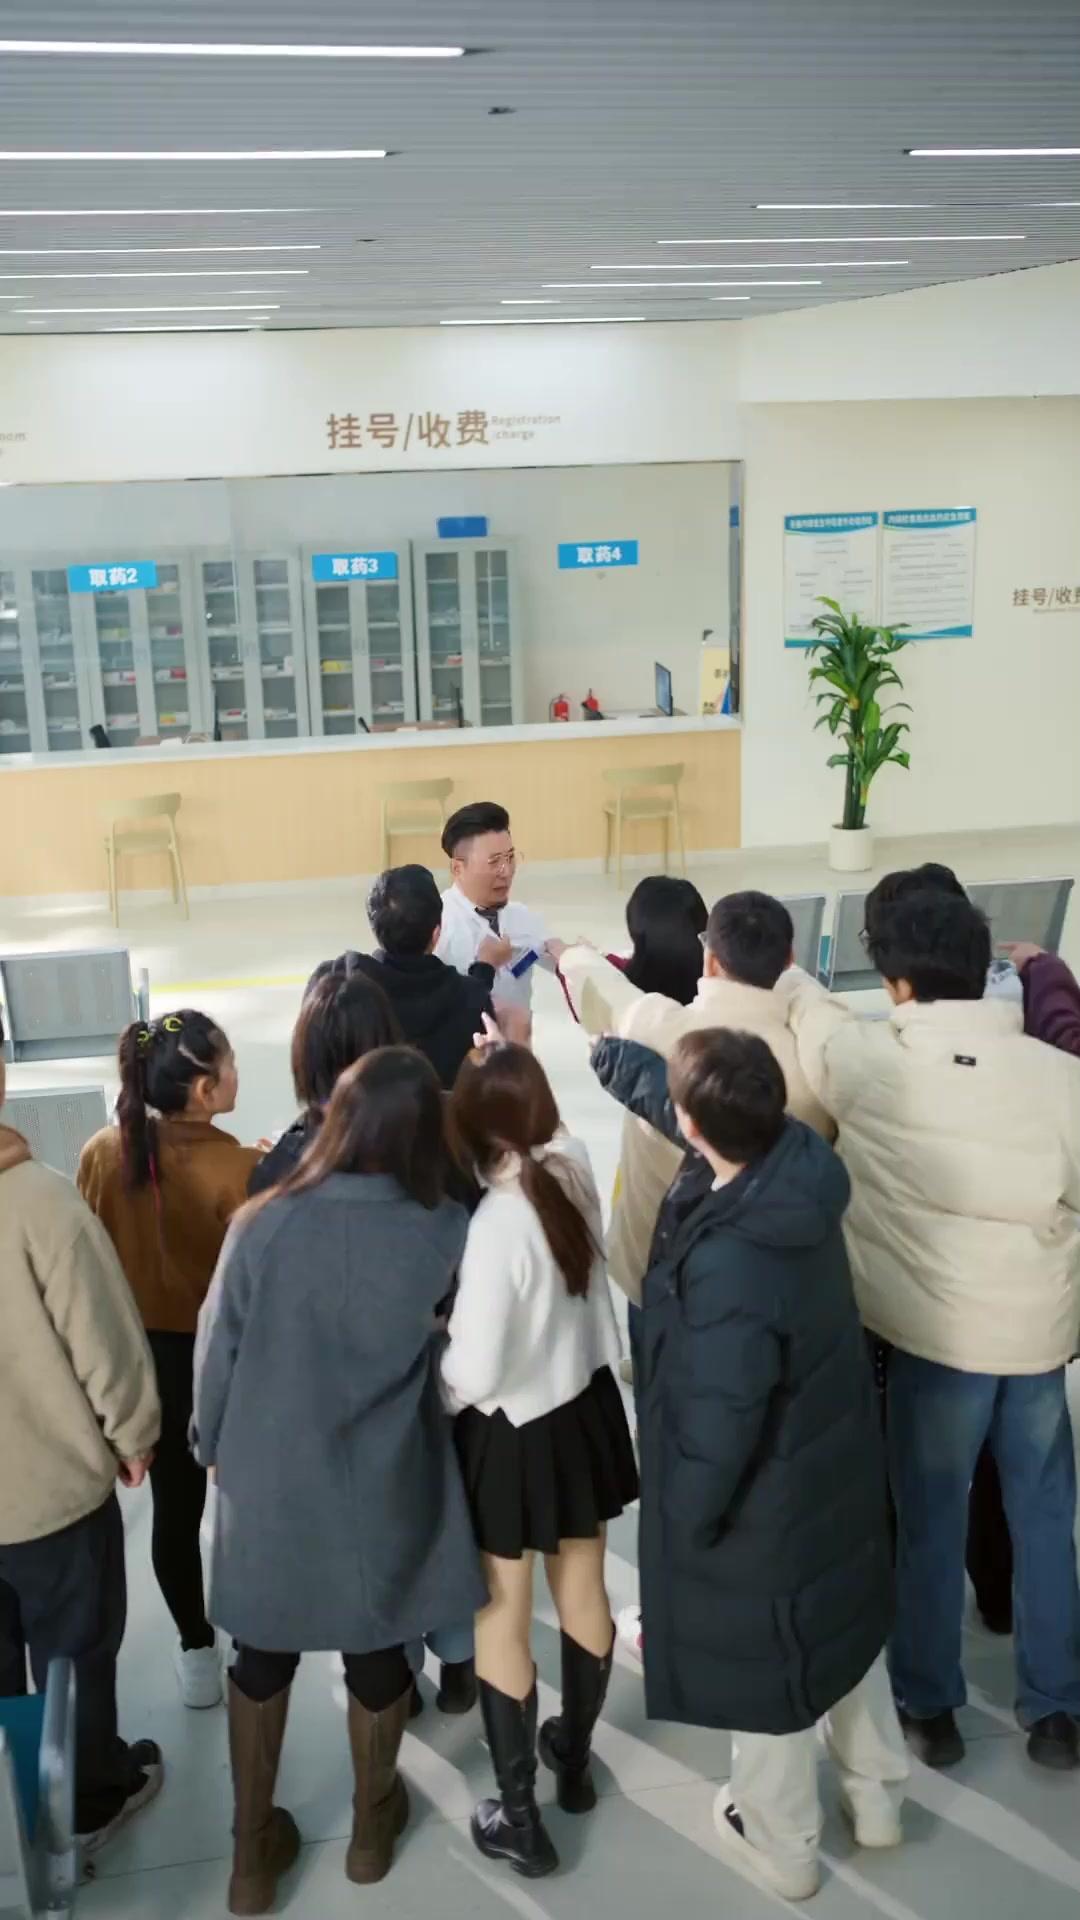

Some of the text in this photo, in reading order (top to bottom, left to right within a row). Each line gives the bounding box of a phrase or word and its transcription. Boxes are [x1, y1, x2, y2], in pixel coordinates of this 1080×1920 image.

[326, 409, 489, 451] 挂号/收费
[576, 545, 623, 564] 取药4
[88, 566, 138, 586] 取药2
[332, 557, 379, 576] 取药3
